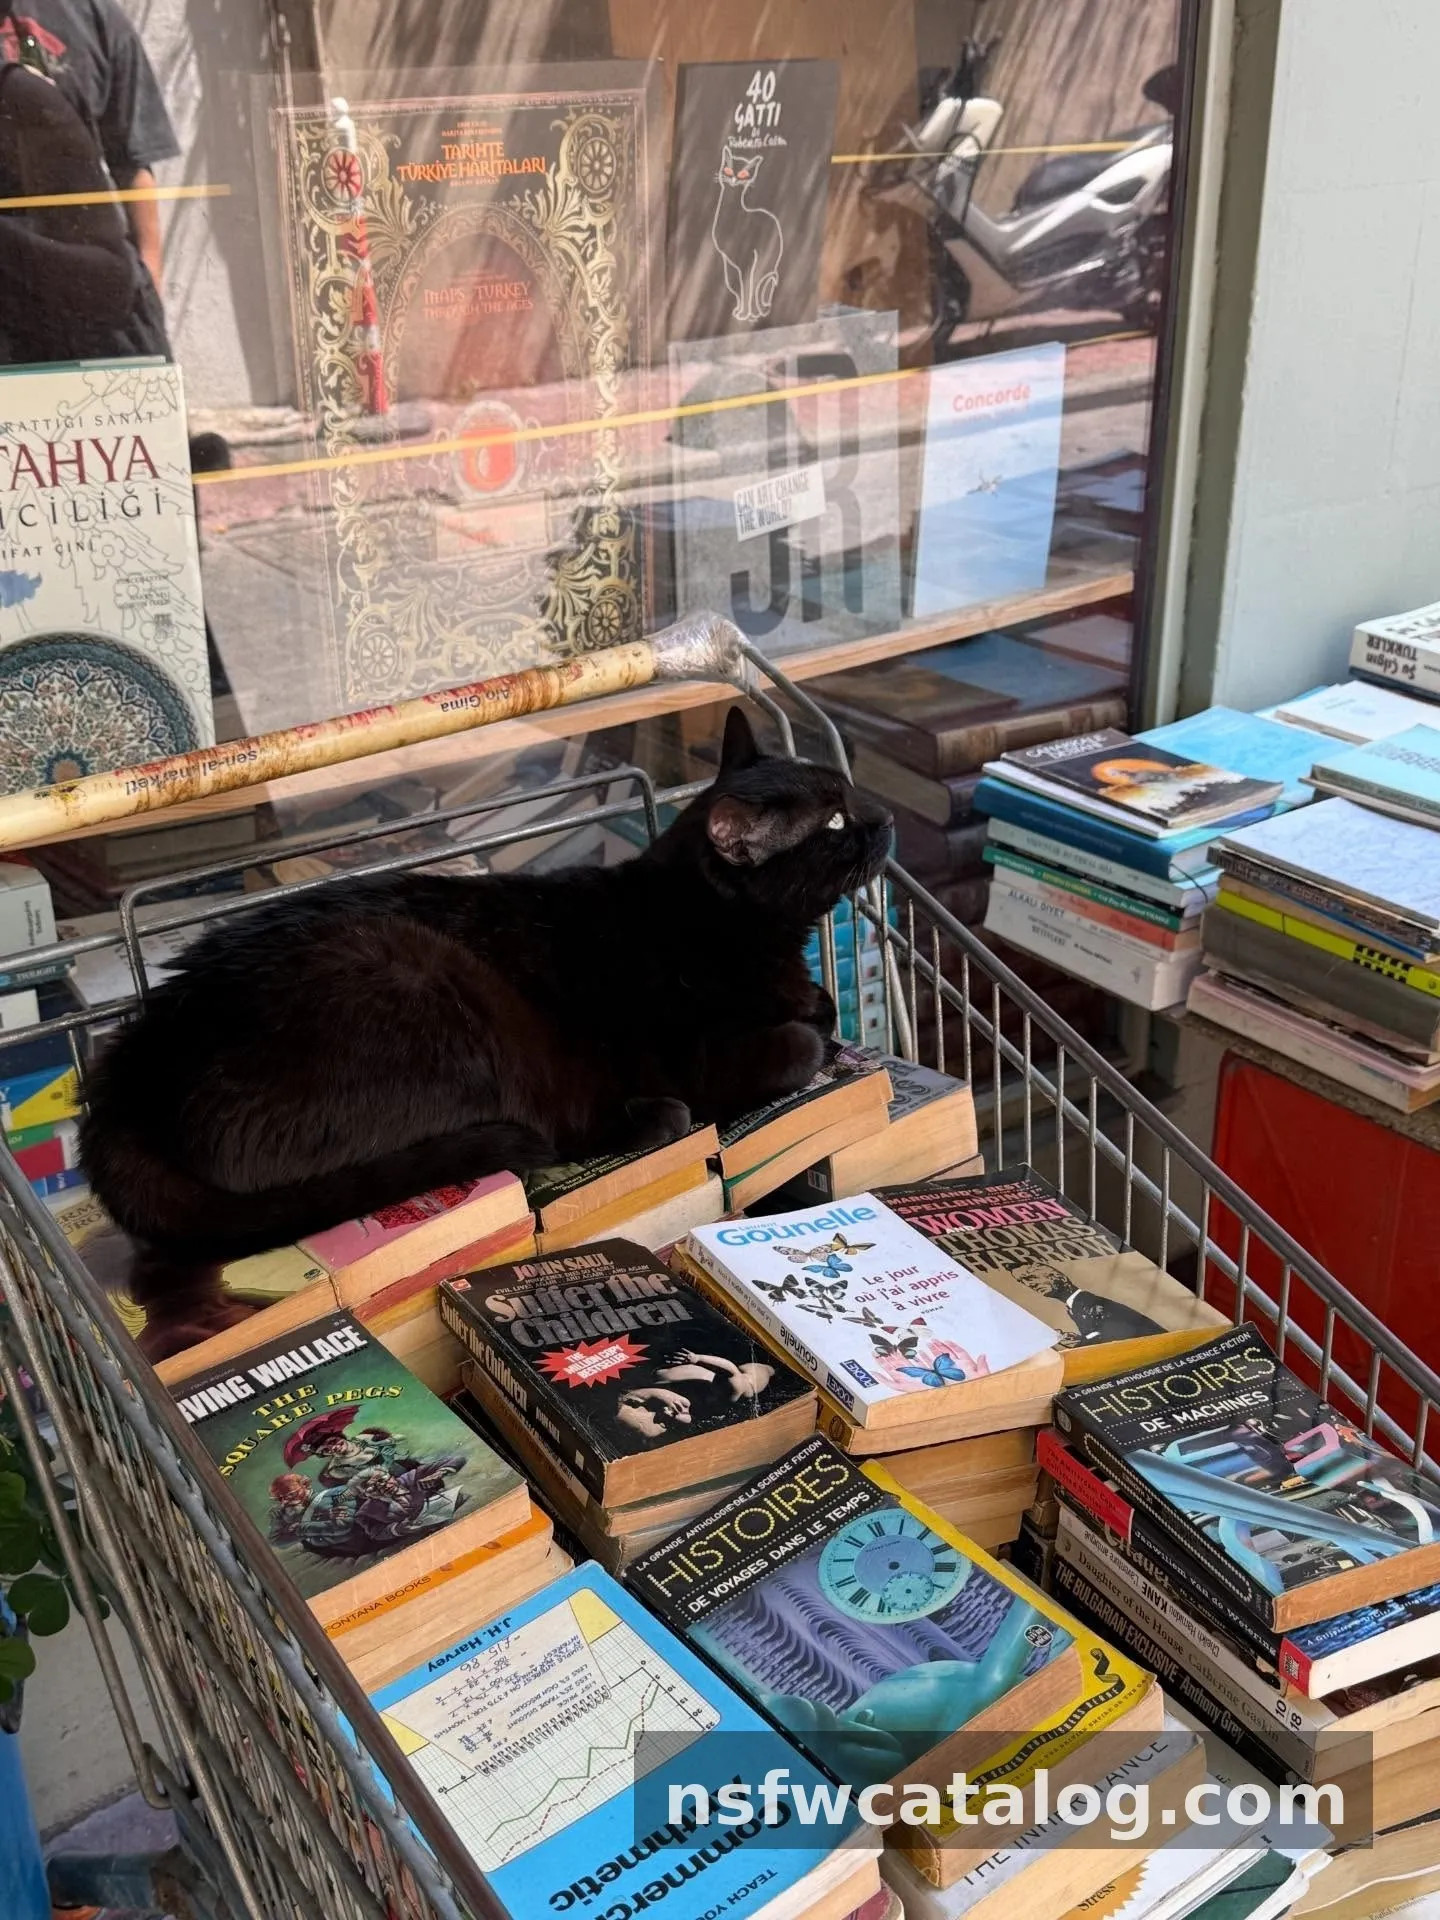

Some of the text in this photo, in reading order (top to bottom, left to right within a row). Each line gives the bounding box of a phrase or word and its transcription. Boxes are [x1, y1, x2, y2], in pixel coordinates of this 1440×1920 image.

[746, 69, 777, 104] 40
[734, 102, 781, 132] GATTI
[475, 281, 531, 300] TURKEY
[952, 382, 1031, 414] Concorde
[95, 411, 155, 427] SANAT
[736, 471, 811, 513] CAN ART CHANGE
[738, 508, 757, 532] THE
[440, 696, 482, 714] Gima
[716, 1203, 878, 1248] Gounelle
[905, 1198, 1072, 1235] WOMEN
[945, 1224, 974, 1234] AND
[932, 1216, 1096, 1255] THOMAS
[563, 1251, 609, 1271] SAUL
[955, 1234, 1119, 1273] HARROW
[853, 1268, 959, 1305] où j'ai appris
[861, 1262, 920, 1287] Le jour
[484, 1270, 678, 1325] Suffer the
[892, 1287, 949, 1312] à vivre
[509, 1296, 693, 1351] Children
[248, 1325, 369, 1388] WALLACE
[563, 1344, 623, 1373] MILLION COPY
[564, 1352, 585, 1362] THE
[576, 1352, 629, 1378] BESTSELLER
[779, 1325, 818, 1371] Gounelle
[484, 1344, 529, 1411] Children
[842, 1360, 877, 1388] POCKET
[1068, 1391, 1080, 1400] LA
[1081, 1379, 1114, 1399] GRANDE
[1116, 1364, 1161, 1389] ANTHOLOGIE
[1161, 1362, 1174, 1372] DE
[1175, 1358, 1186, 1367] LA
[1080, 1346, 1277, 1423] HISTOIRES
[251, 1382, 319, 1417] THE
[1140, 1390, 1270, 1434] DE MACHINES
[218, 1402, 313, 1477] SQUARE
[326, 1384, 404, 1406] PEGS
[635, 1439, 823, 1572] LA GRANDE ANTHOLOGIE DE LA SCIENCE FICTION
[646, 1451, 849, 1598] HISTOIRES
[687, 1489, 870, 1614] DE VOYAGES DANS LE TEMPS
[384, 1574, 431, 1603] BOOKS
[1132, 1528, 1278, 1658] Janwillem van Wetering
[1139, 1583, 1172, 1614] KANE
[426, 1617, 513, 1673] J.H. Harvey
[1073, 1550, 1123, 1597] Daughter
[1120, 1592, 1137, 1609] of
[1133, 1605, 1153, 1623] the
[1149, 1618, 1188, 1655] House
[1183, 1651, 1242, 1706] Catherine
[458, 1656, 481, 1675] 86
[1049, 1560, 1078, 1588] THE
[1067, 1576, 1131, 1636] BULGARIAN
[1176, 1675, 1226, 1722] Anthony
[1214, 1710, 1248, 1744] Grey
[521, 1661, 557, 1685] INTEREST
[504, 1706, 538, 1729] DISCOUNT
[505, 1692, 542, 1717] DISCOUNT
[1273, 1698, 1289, 1718] 10
[1289, 1711, 1304, 1732] 18
[727, 1868, 778, 1907] TEACH
[1077, 1879, 1117, 1914] Stress
